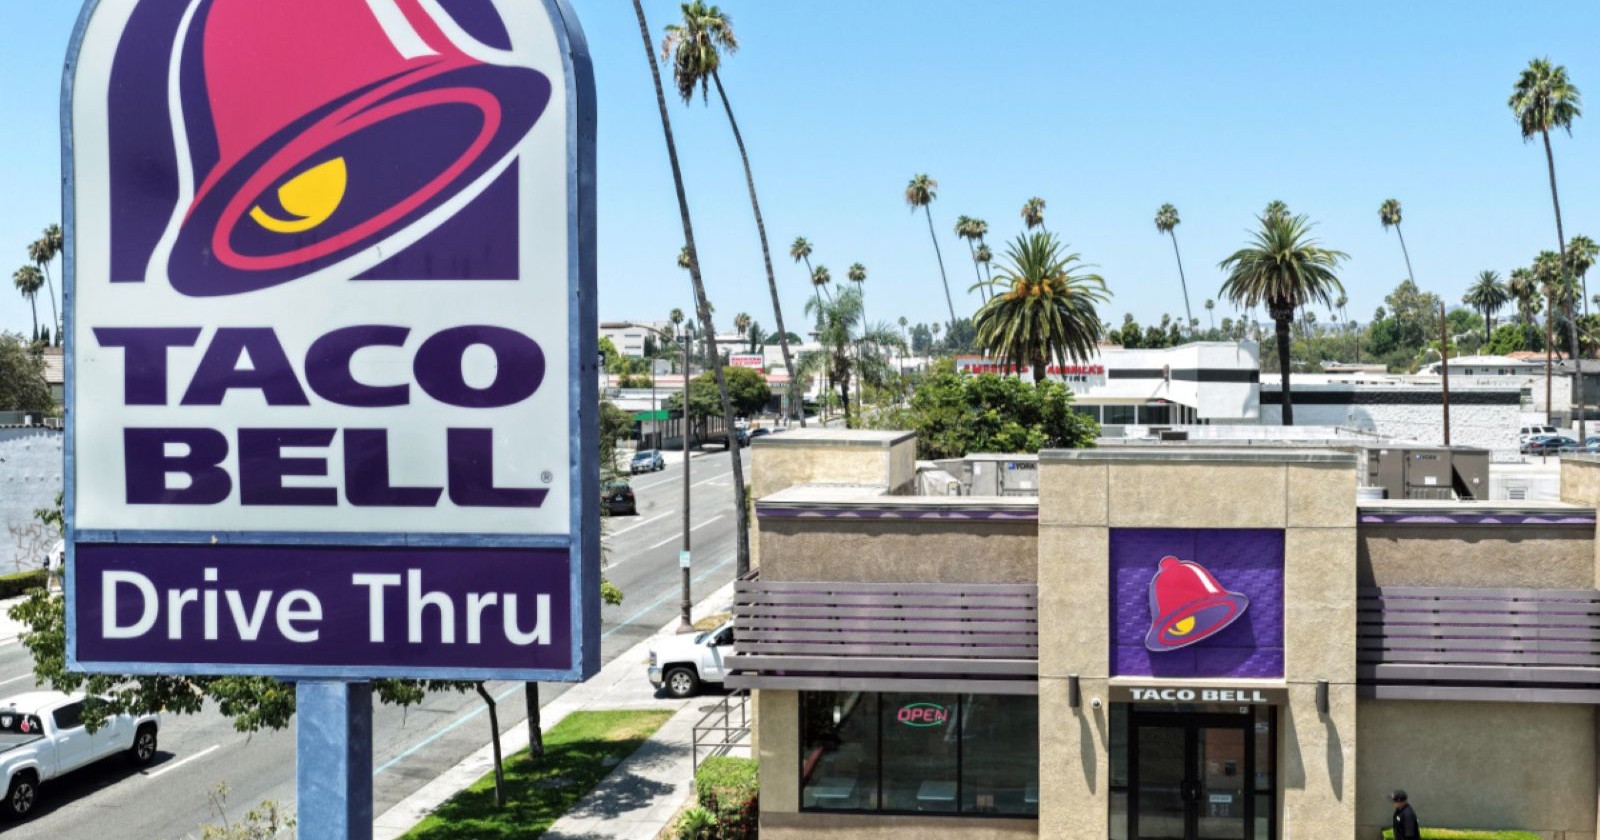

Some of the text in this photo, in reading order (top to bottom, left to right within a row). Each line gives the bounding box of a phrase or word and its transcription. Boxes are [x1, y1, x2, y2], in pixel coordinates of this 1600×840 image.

[93, 325, 546, 408] TACO
[123, 427, 550, 508] BELL
[102, 568, 551, 644] Drive Thru
[897, 707, 947, 721] OPEN
[1129, 688, 1268, 702] TACO BELL
